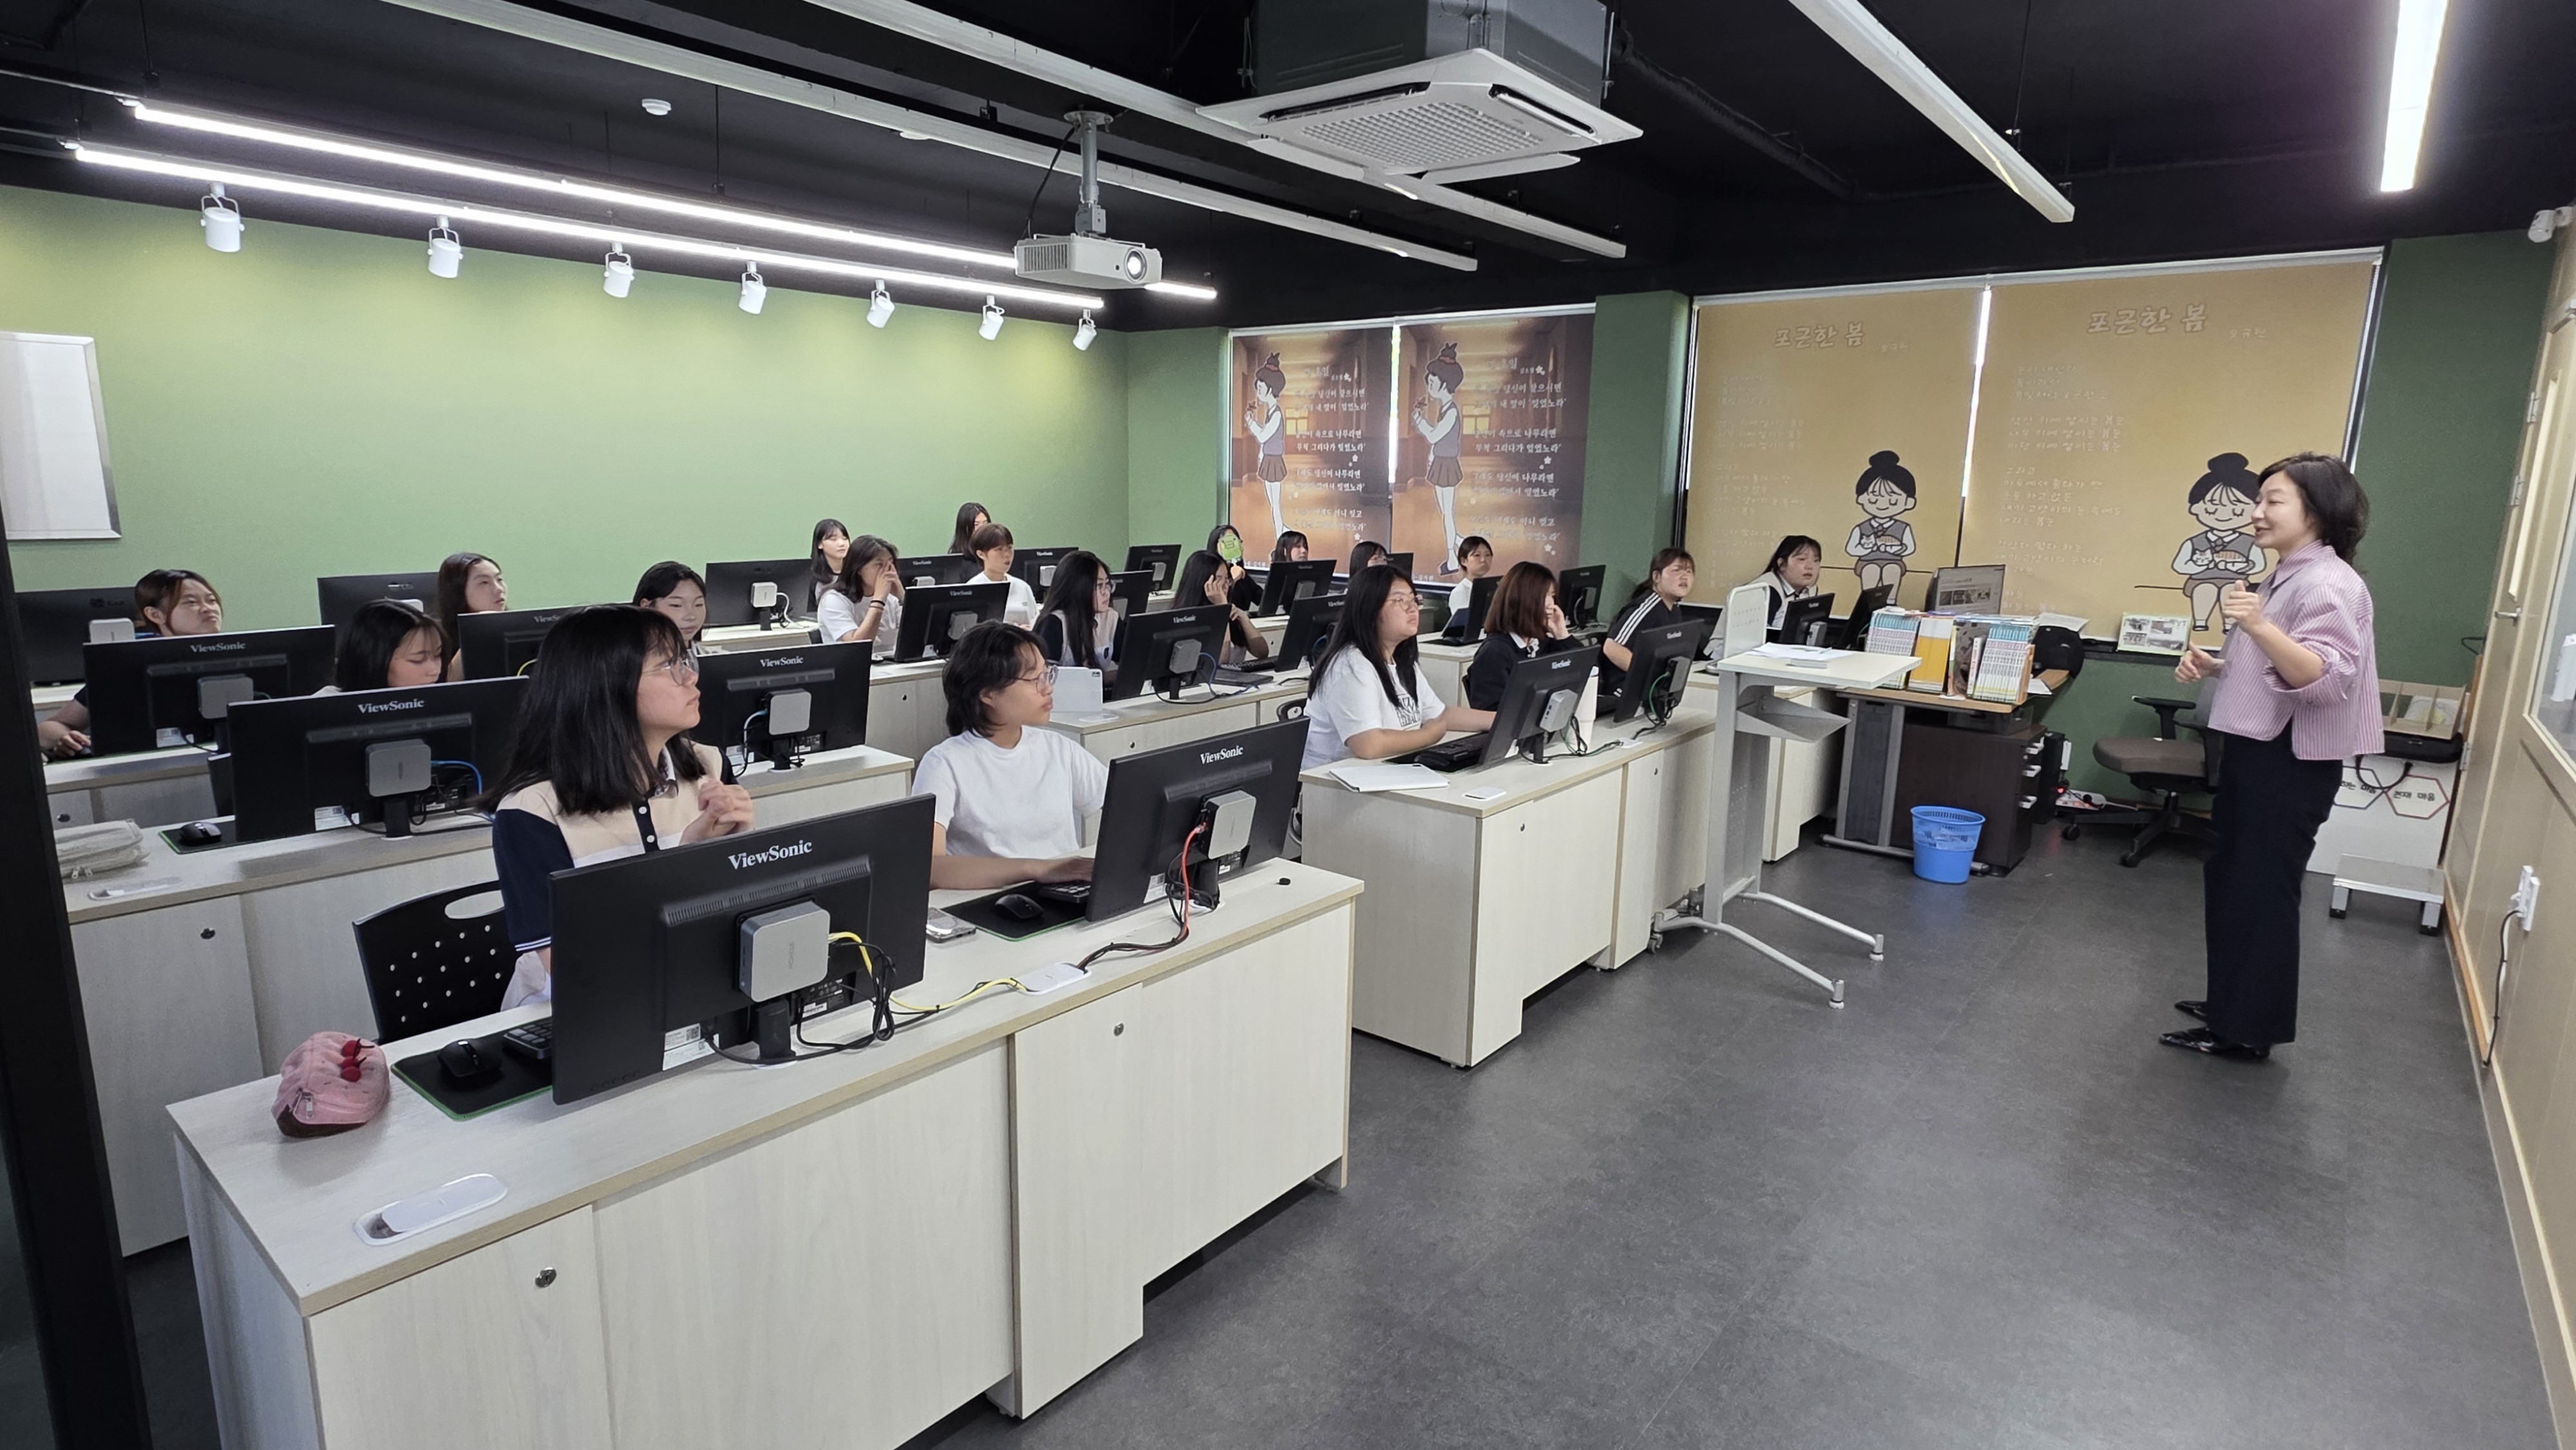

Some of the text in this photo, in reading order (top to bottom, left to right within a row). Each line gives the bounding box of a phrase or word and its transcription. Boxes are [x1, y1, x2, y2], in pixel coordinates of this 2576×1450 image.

[2087, 303, 2208, 335] 포근한 봄
[1774, 321, 1865, 348] 포근한 봄
[190, 641, 246, 652] ViewSonic
[760, 656, 804, 668] ViewSonic
[357, 698, 425, 713] ViewSonic
[1200, 745, 1244, 765] ViewSonic
[728, 840, 813, 871] ViewSonic
